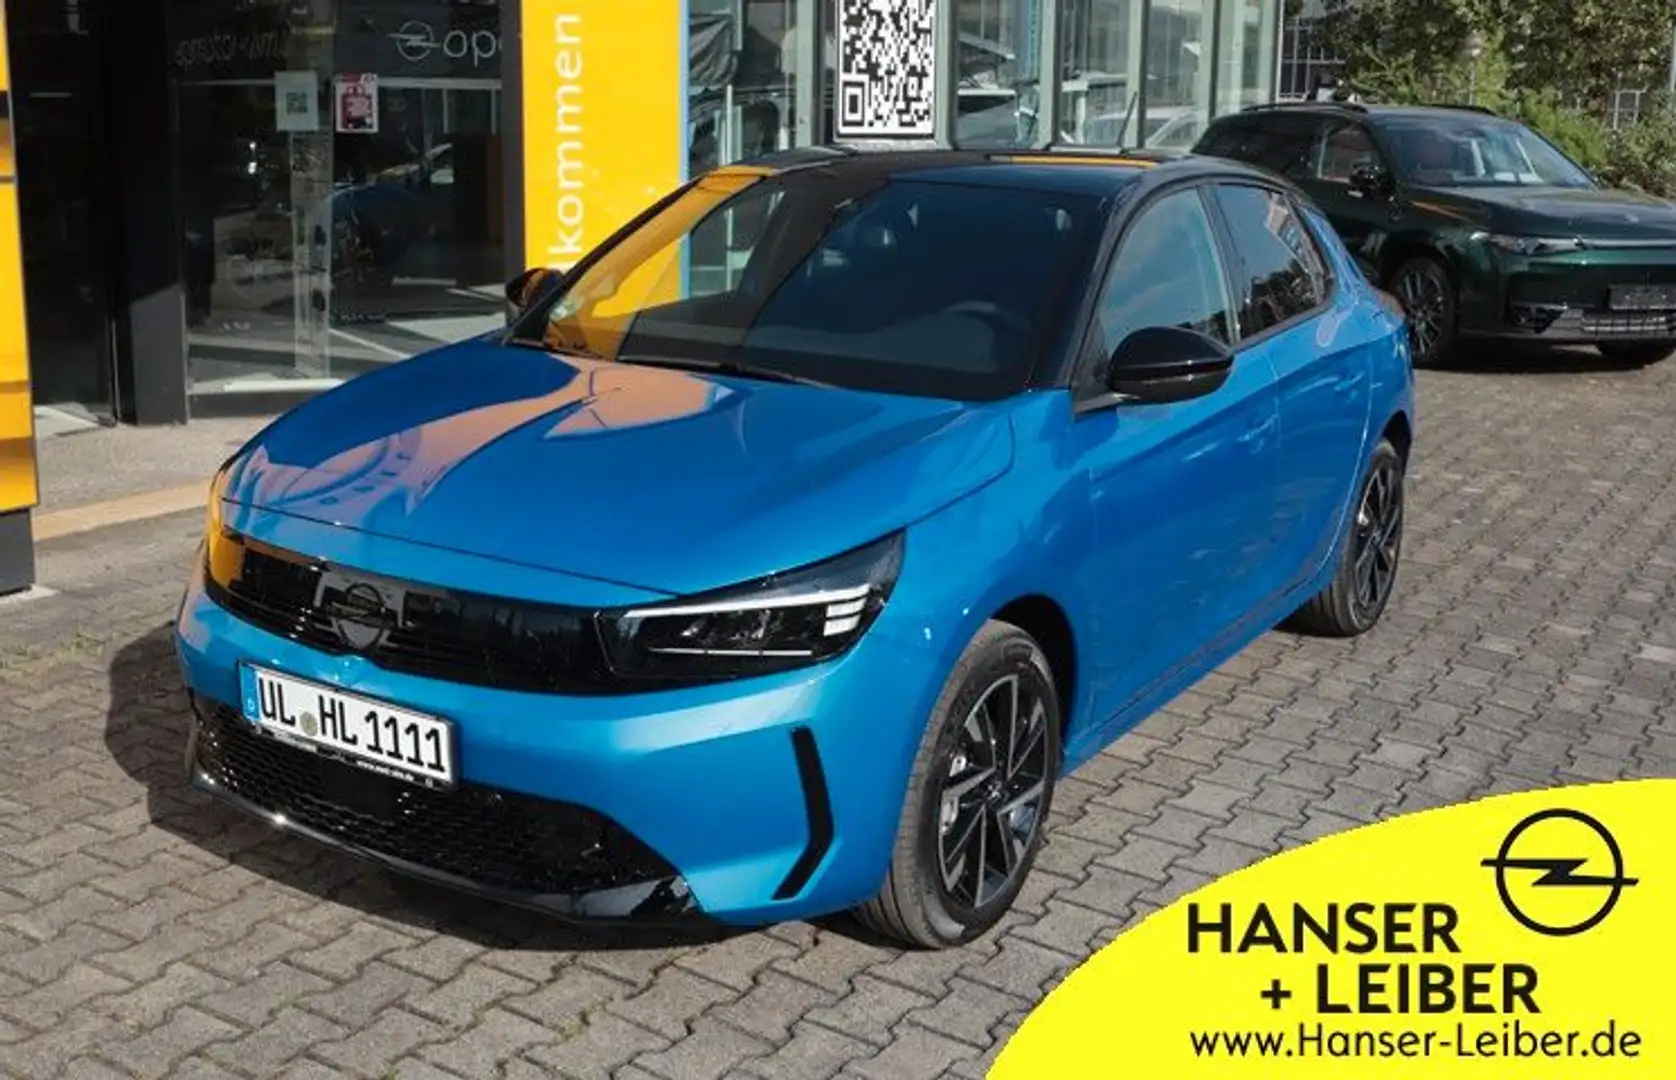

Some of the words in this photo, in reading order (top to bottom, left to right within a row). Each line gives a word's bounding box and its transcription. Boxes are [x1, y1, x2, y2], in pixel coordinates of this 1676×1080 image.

[443, 30, 502, 68] op
[547, 13, 584, 270] lkommen
[259, 678, 296, 727] UL
[319, 696, 358, 746] HL
[365, 711, 446, 773] 1111
